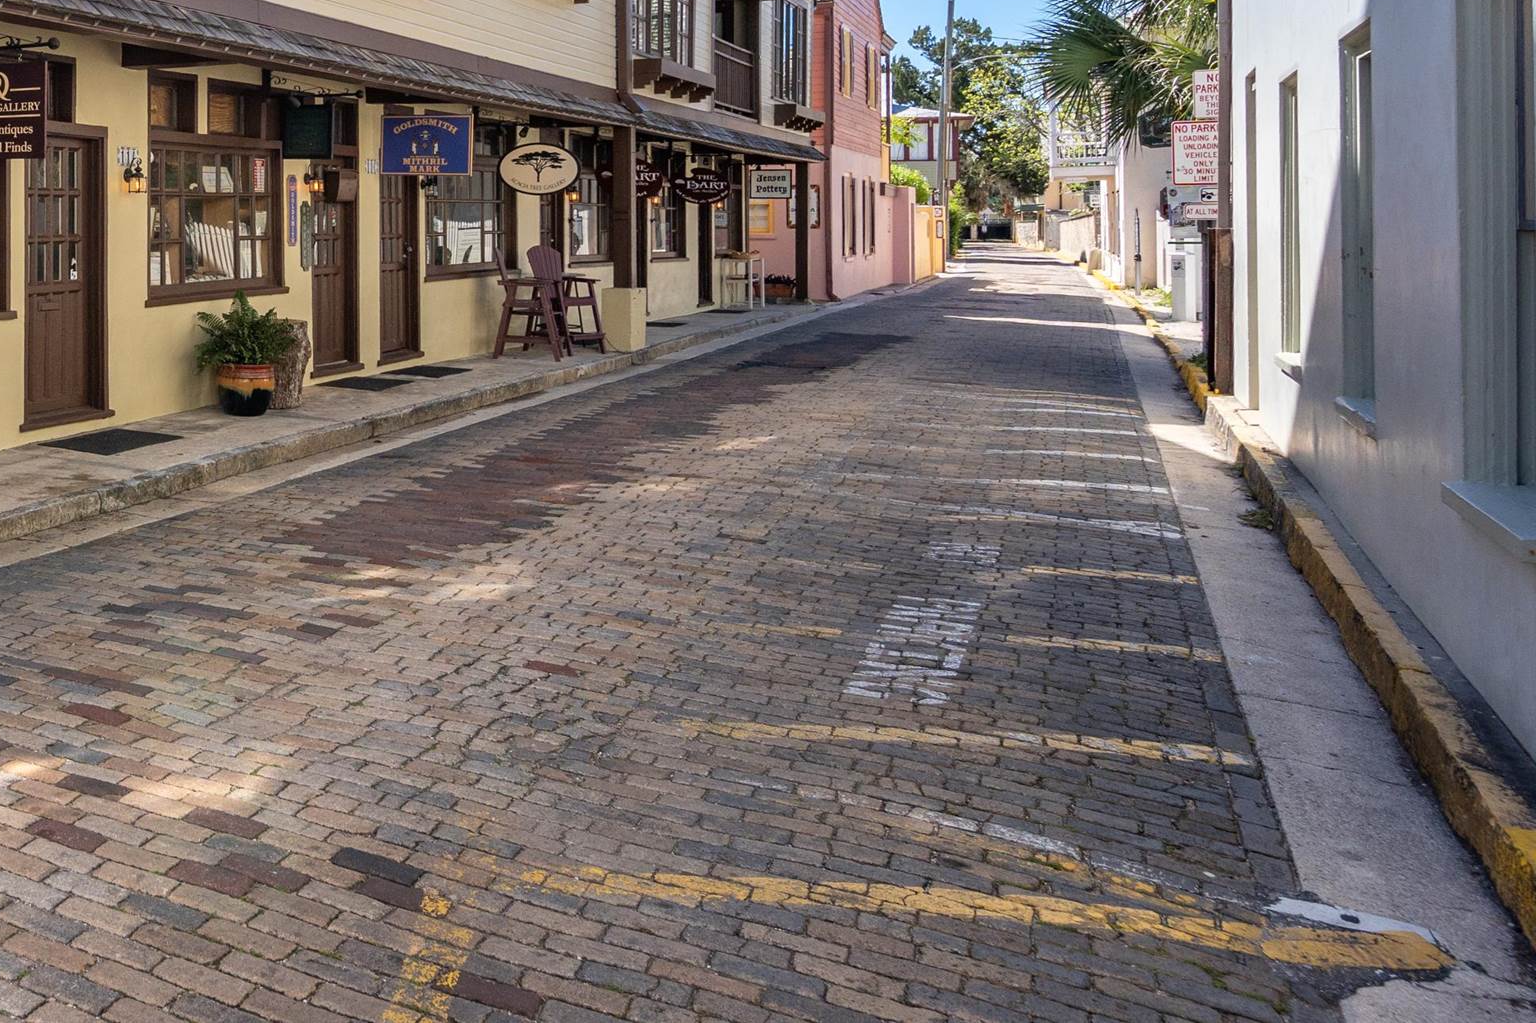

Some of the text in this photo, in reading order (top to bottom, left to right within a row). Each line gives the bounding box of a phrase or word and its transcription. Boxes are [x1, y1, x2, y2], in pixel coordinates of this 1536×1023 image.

[1195, 84, 1219, 94] PARK
[393, 118, 458, 135] GOLDSMITH
[1175, 124, 1218, 133] NO PARK
[4, 140, 33, 153] Finds
[1185, 151, 1217, 159] VEHICLE
[402, 157, 448, 166] MITHRIL
[409, 165, 440, 173] MARK
[756, 174, 786, 182] Jensen
[756, 185, 788, 195] Pottery
